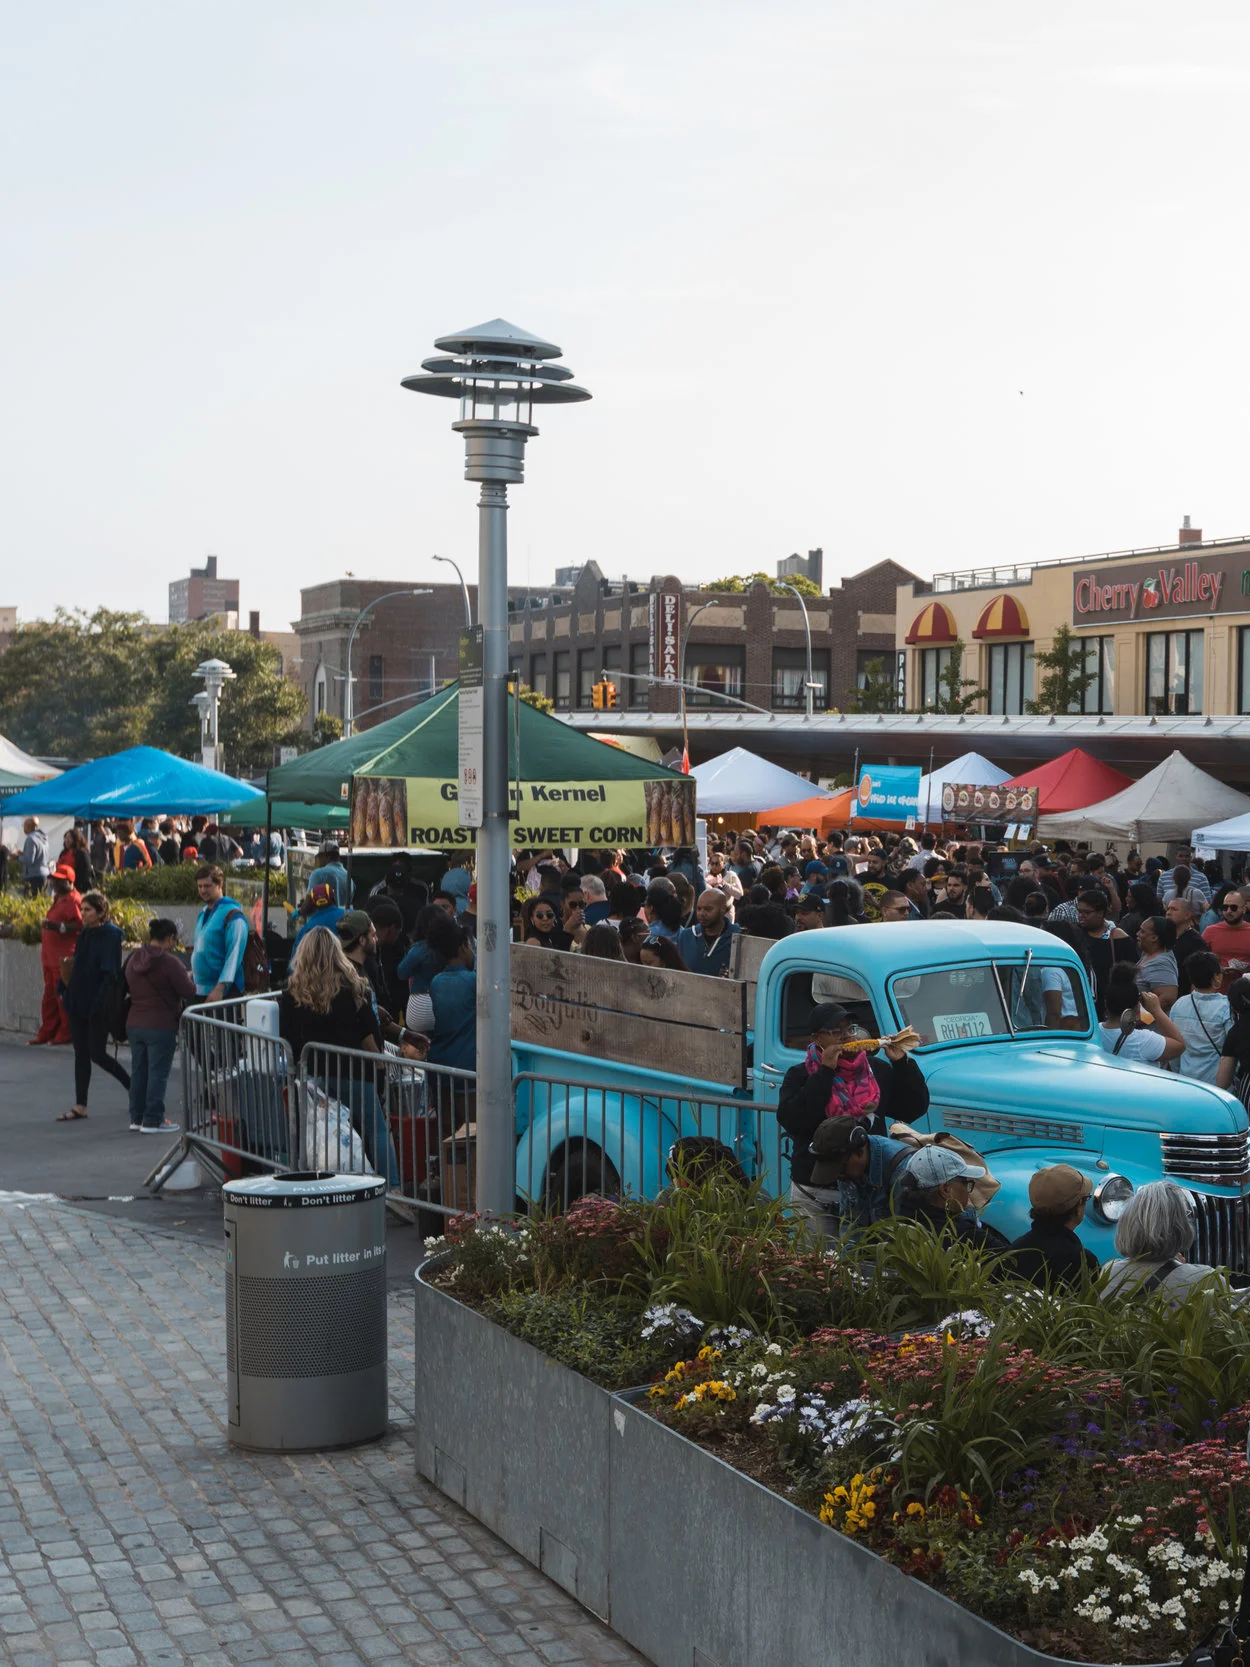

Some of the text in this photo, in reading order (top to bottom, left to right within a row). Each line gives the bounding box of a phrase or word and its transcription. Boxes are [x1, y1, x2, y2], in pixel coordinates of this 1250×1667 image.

[1076, 574, 1140, 618] Cherry
[1159, 562, 1222, 610] Valley
[532, 784, 606, 802] Kernel
[411, 827, 643, 844] ROAST SWEET CORN
[230, 1194, 272, 1206] Don't litter
[301, 1193, 356, 1205] Don't litter
[306, 1254, 329, 1266] Put
[332, 1251, 360, 1264] litter
[363, 1248, 372, 1259] in
